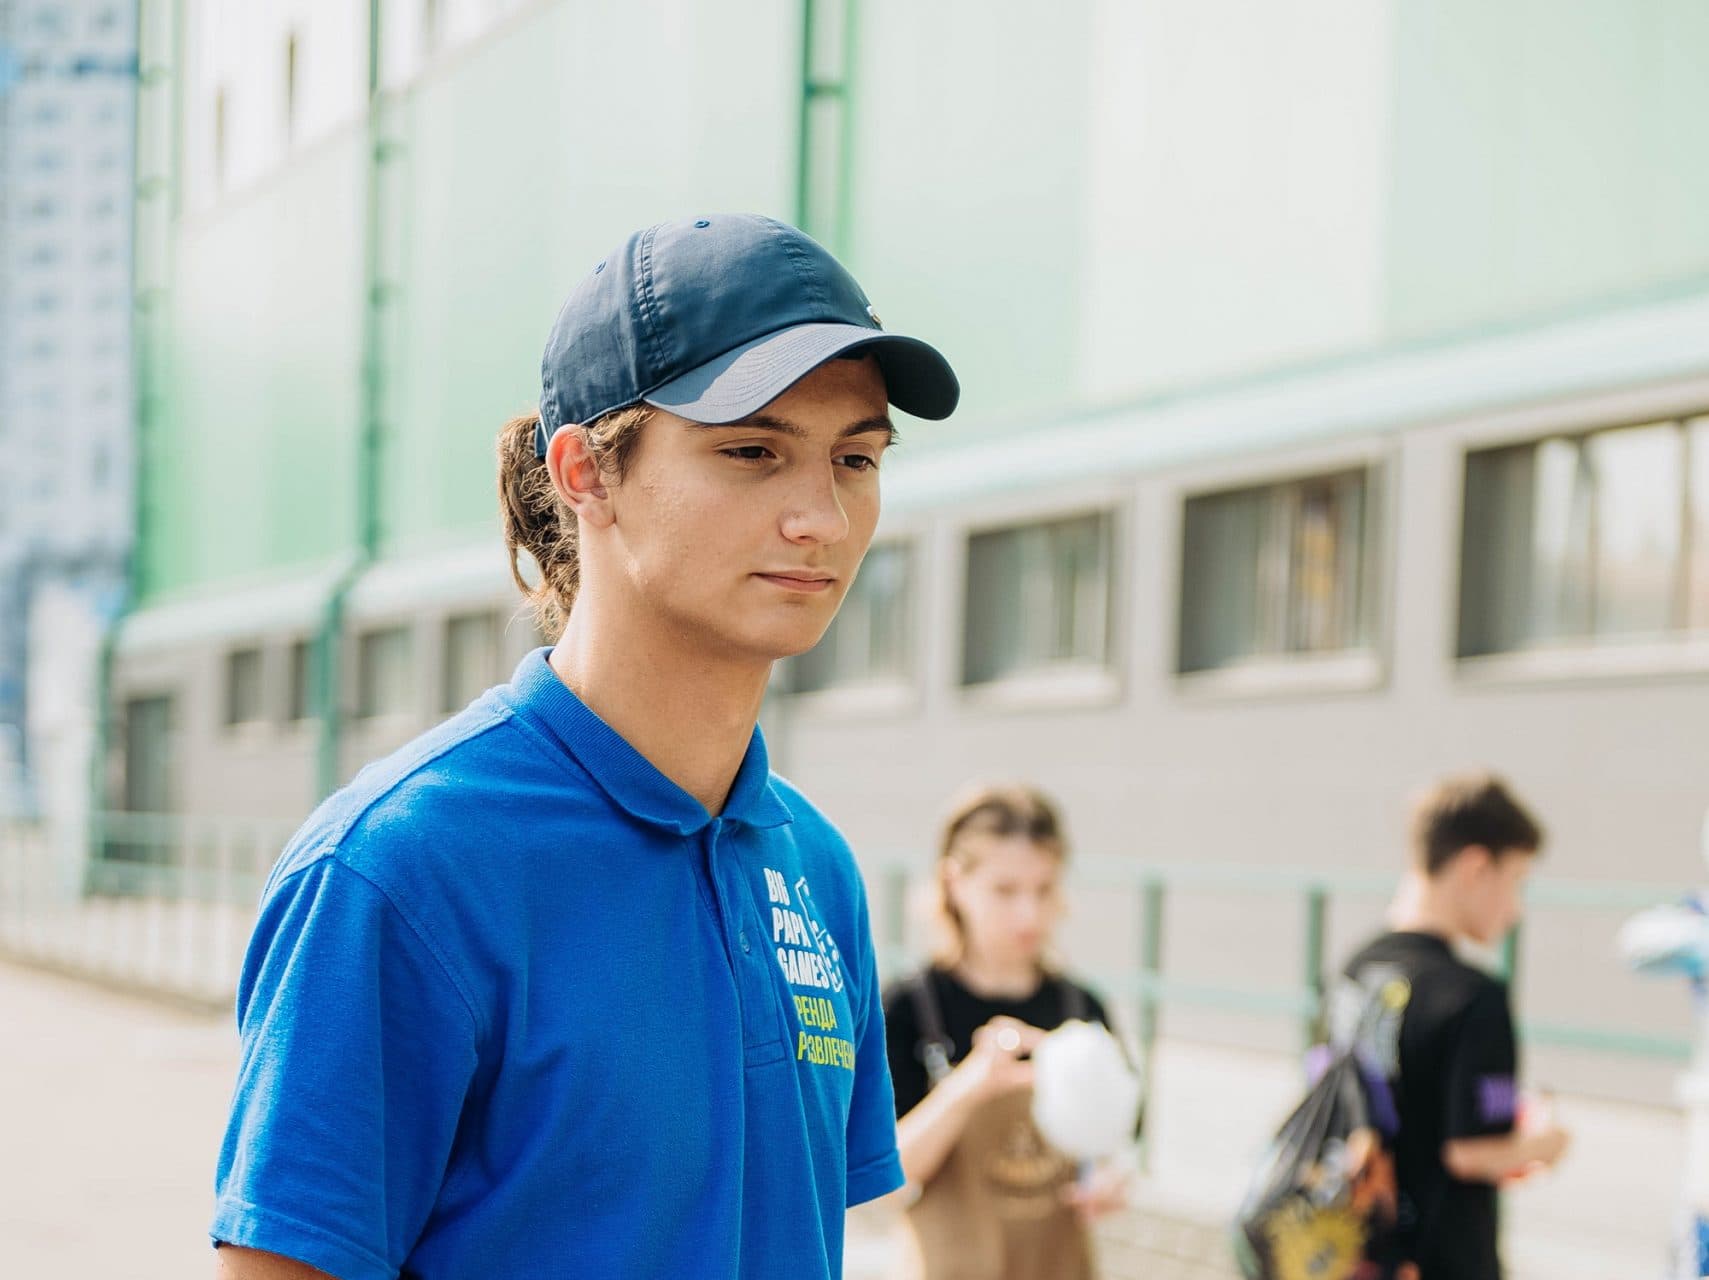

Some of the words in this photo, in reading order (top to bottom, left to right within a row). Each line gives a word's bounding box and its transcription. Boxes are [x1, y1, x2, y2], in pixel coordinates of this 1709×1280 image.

[763, 867, 790, 906] BIG
[772, 907, 812, 948] PAPA
[777, 947, 830, 989] GAMES
[793, 995, 838, 1031] РЕНДА
